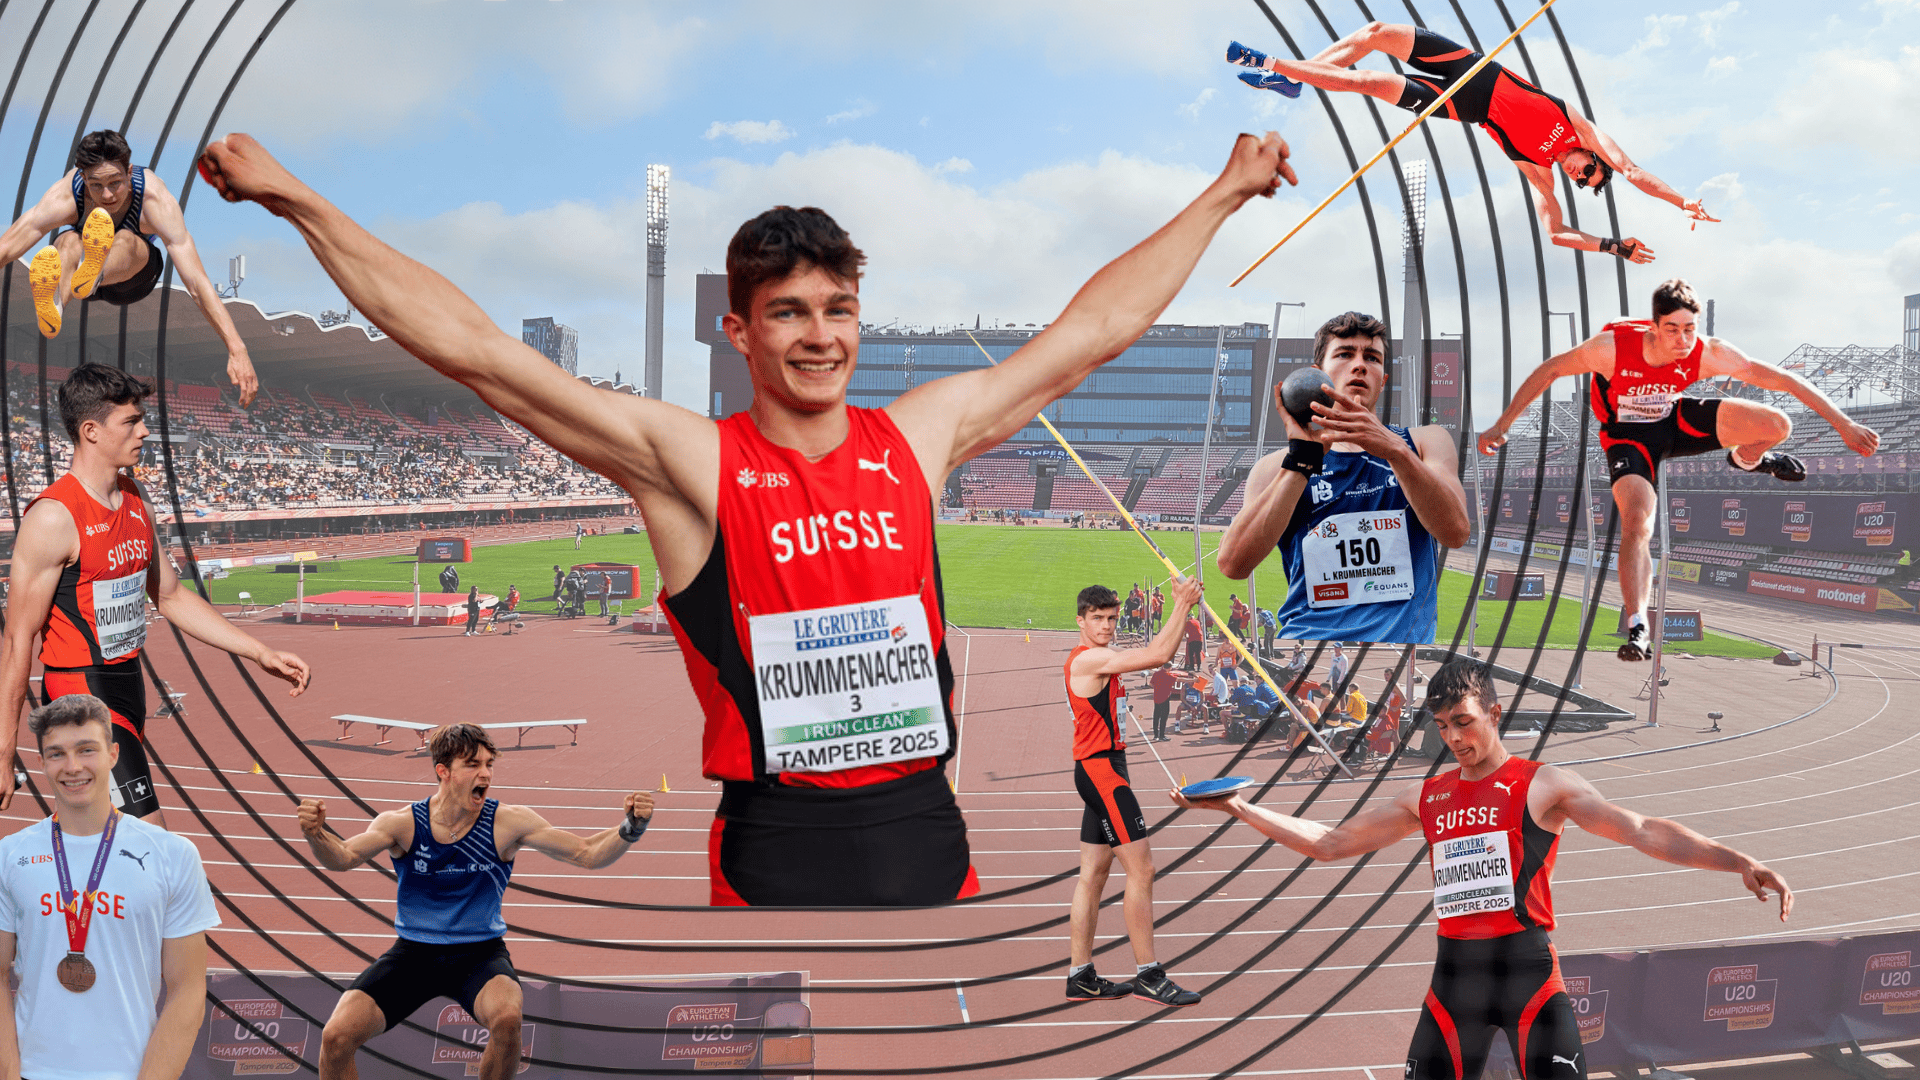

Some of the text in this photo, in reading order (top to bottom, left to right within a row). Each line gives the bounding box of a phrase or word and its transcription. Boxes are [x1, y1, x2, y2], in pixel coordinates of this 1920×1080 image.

[1728, 510, 1740, 519] U20
[1791, 514, 1804, 523] U20
[1864, 514, 1884, 526] U20
[94, 523, 110, 534] UBS
[1373, 518, 1401, 530] UBS
[1336, 537, 1381, 568] 150
[1324, 566, 1396, 581] L. KRUMMENACHER
[112, 583, 121, 593] LE
[1374, 582, 1408, 591] EQUANS
[1817, 588, 1866, 604] motonet
[794, 606, 890, 640] LE GRUYÈRE
[104, 640, 135, 656] TAMPERE
[759, 643, 934, 700] KRUMMENACHER
[851, 694, 862, 712] 3
[804, 727, 809, 740] I
[812, 722, 850, 738] RUN
[777, 730, 939, 769] TAMPERE 2025
[1444, 844, 1452, 854] LE
[31, 854, 53, 864] UBS
[1434, 858, 1508, 888] KRUMMENACHER
[1450, 892, 1466, 900] RUN
[1466, 888, 1492, 899] CLEAN
[1438, 897, 1510, 915] TAMPERE 2025
[1880, 970, 1911, 987] U20
[1725, 984, 1756, 1002] U20
[234, 1002, 277, 1010] EUROPEAN
[1570, 998, 1590, 1014] 20
[1708, 1004, 1771, 1016] CHAMPIONSHIPS
[234, 1022, 280, 1040] U20
[462, 1028, 490, 1045] U2
[692, 1024, 734, 1042] U20
[668, 1042, 754, 1056] CHAMPIONSHIPS
[240, 1063, 274, 1072] Tampere
[700, 1060, 732, 1068] Tampere
